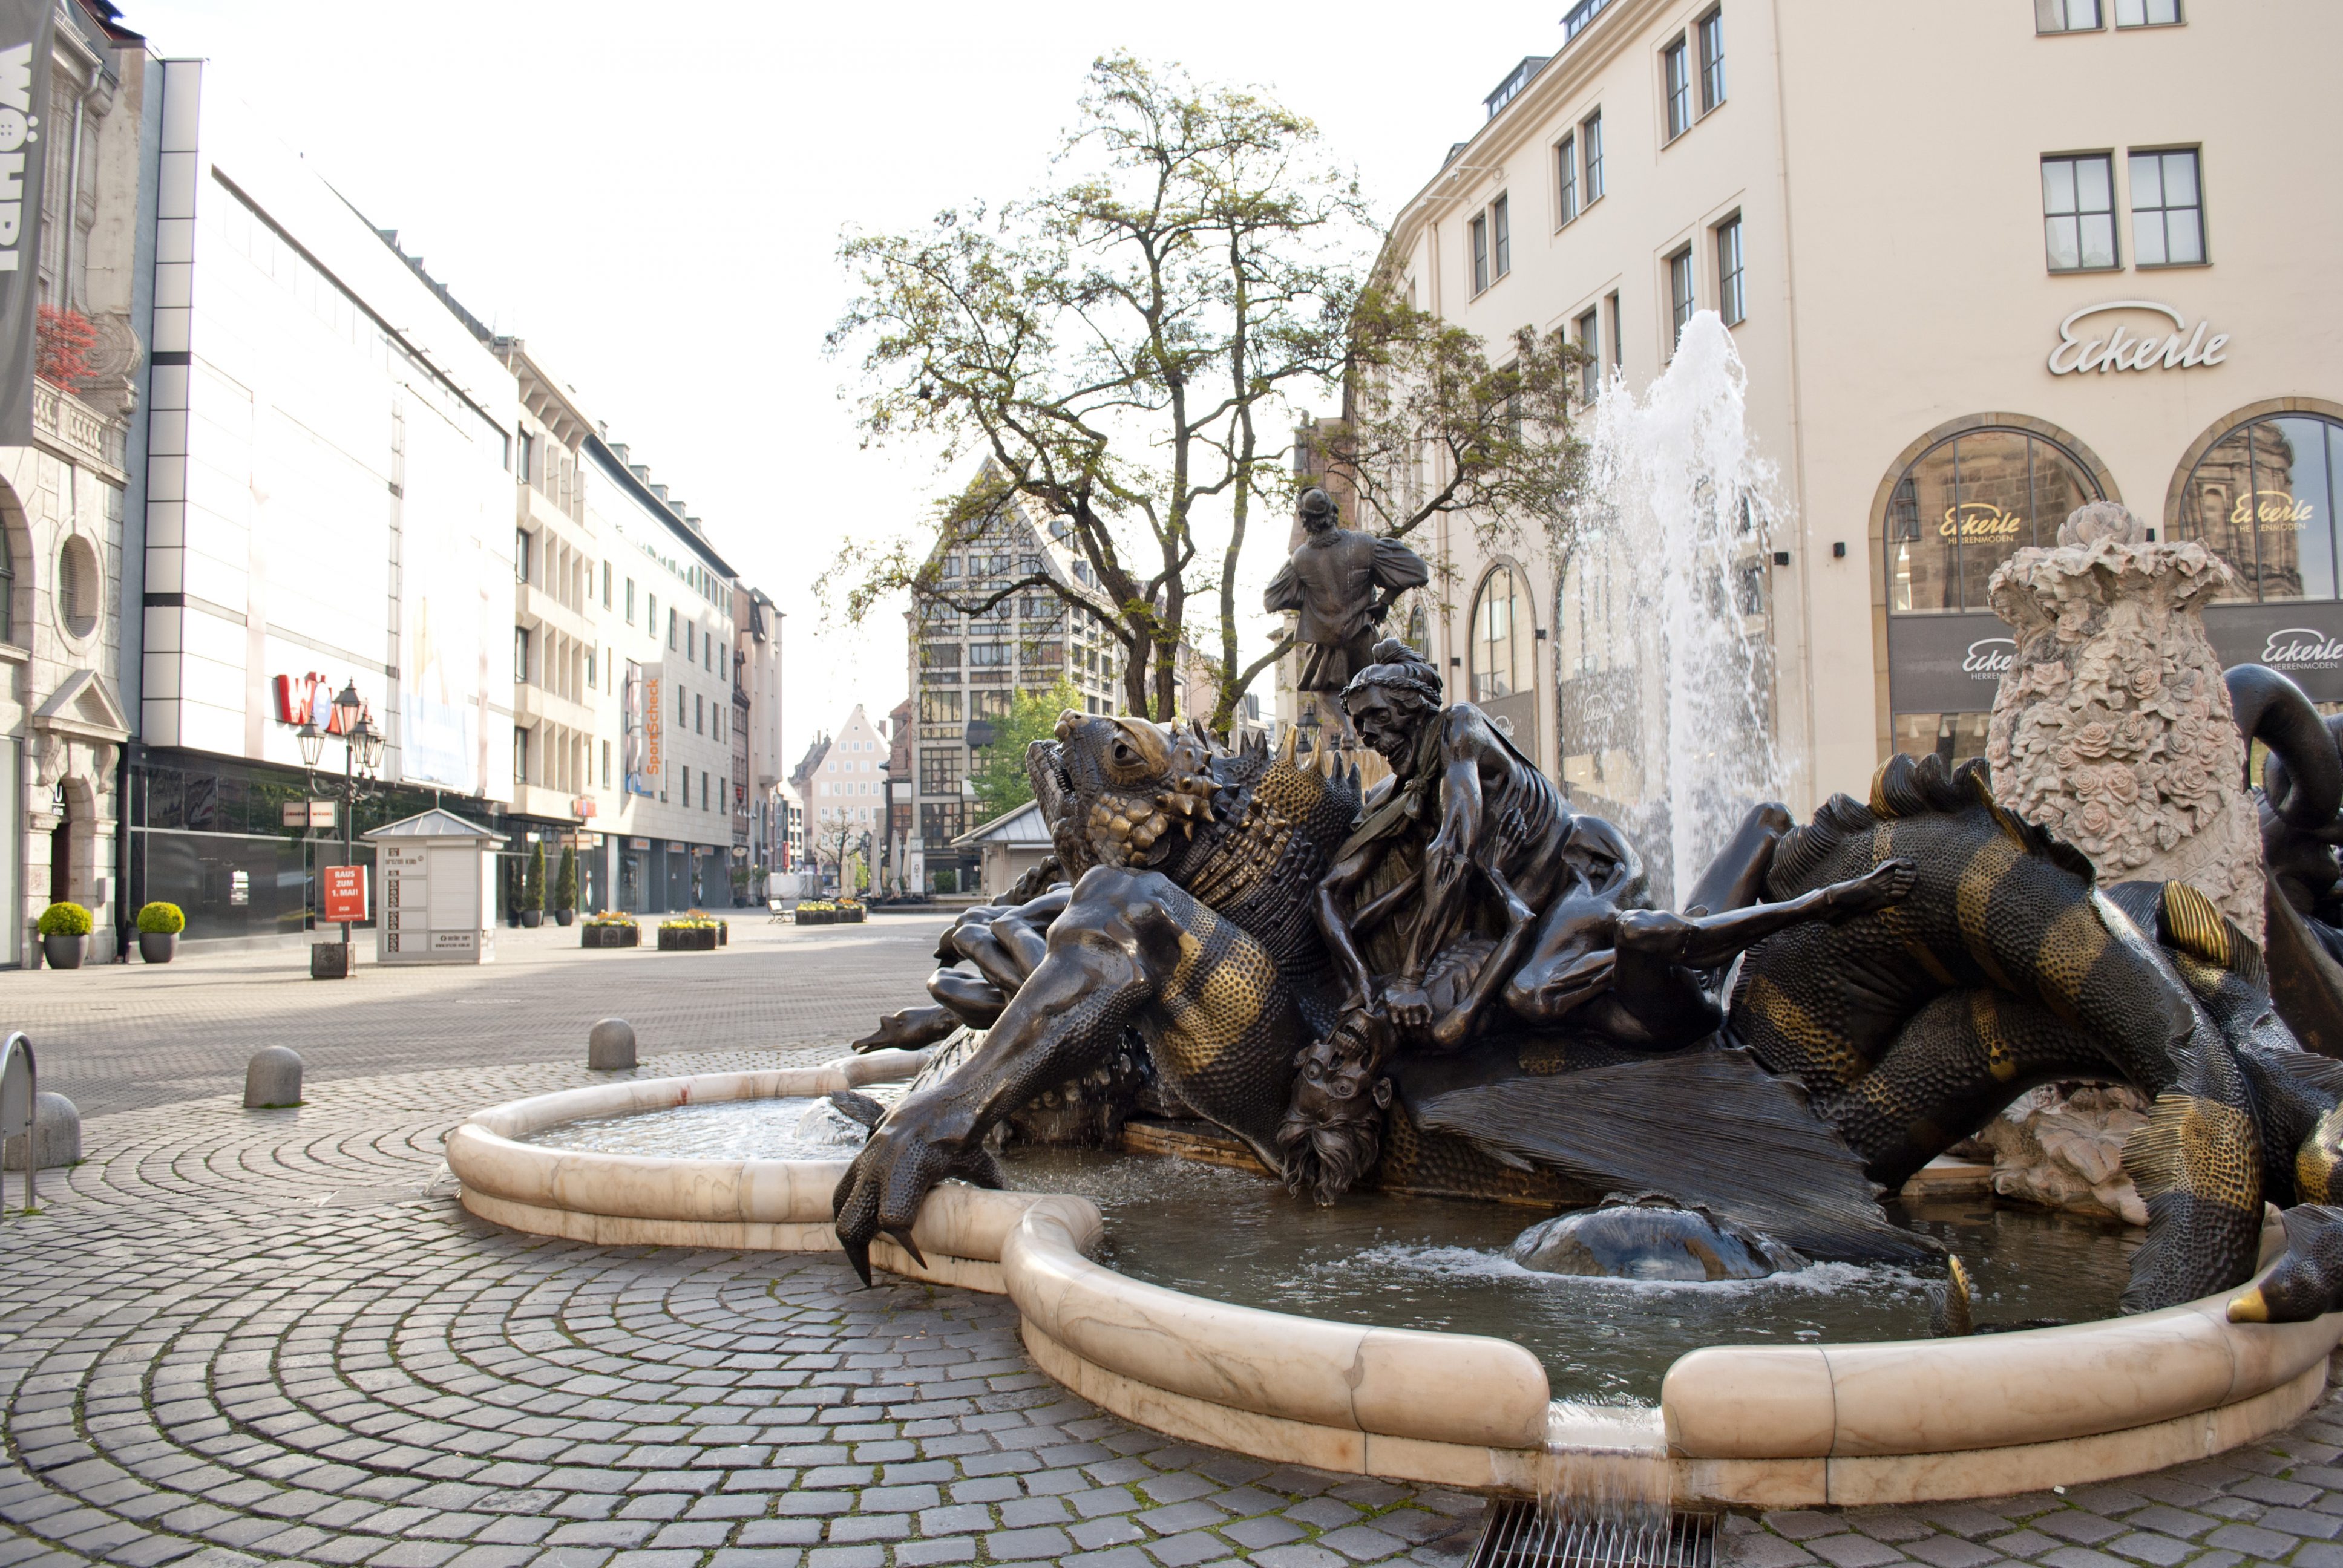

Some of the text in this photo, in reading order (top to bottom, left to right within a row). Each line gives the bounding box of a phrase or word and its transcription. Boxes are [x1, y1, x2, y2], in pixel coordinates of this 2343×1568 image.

[2048, 300, 2230, 374] Eckerle
[2240, 523, 2306, 533] HEENMODEN
[2261, 628, 2343, 662] Eckerle
[1962, 638, 2017, 672] Ecke
[2270, 662, 2338, 671] HERRENMODEN
[1971, 672, 2007, 681] HERREN
[646, 678, 661, 775] SportScheck
[335, 870, 355, 878] RAUS
[336, 879, 354, 887] ZUM
[339, 888, 358, 897] MAI!
